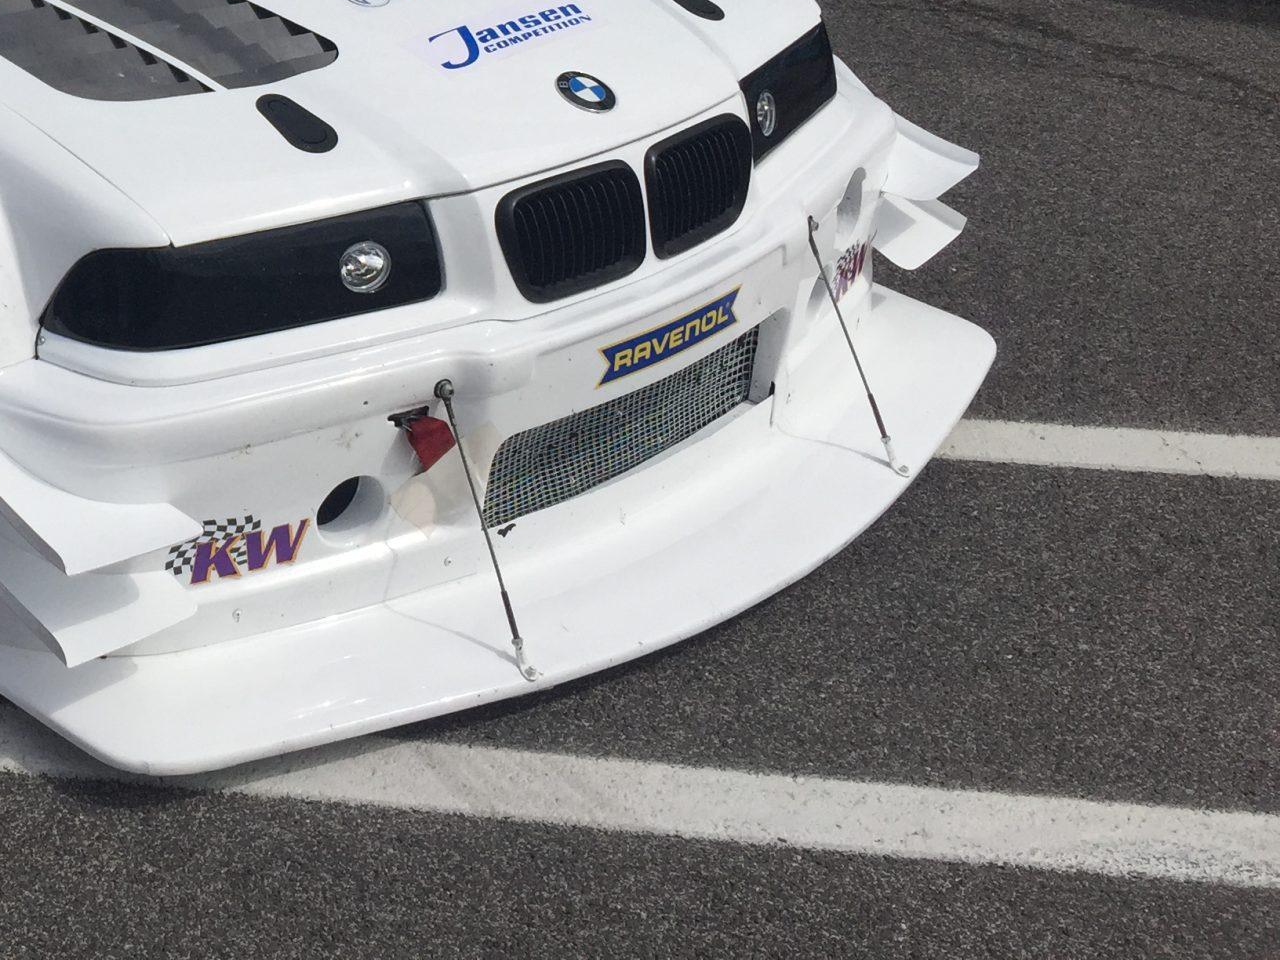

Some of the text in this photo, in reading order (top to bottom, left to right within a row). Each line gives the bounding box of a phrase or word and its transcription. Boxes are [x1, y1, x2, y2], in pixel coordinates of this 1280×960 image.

[428, 3, 582, 70] Jansen
[483, 14, 592, 54] COMPETITION
[613, 305, 729, 373] RAVENOL
[190, 518, 312, 585] KW
